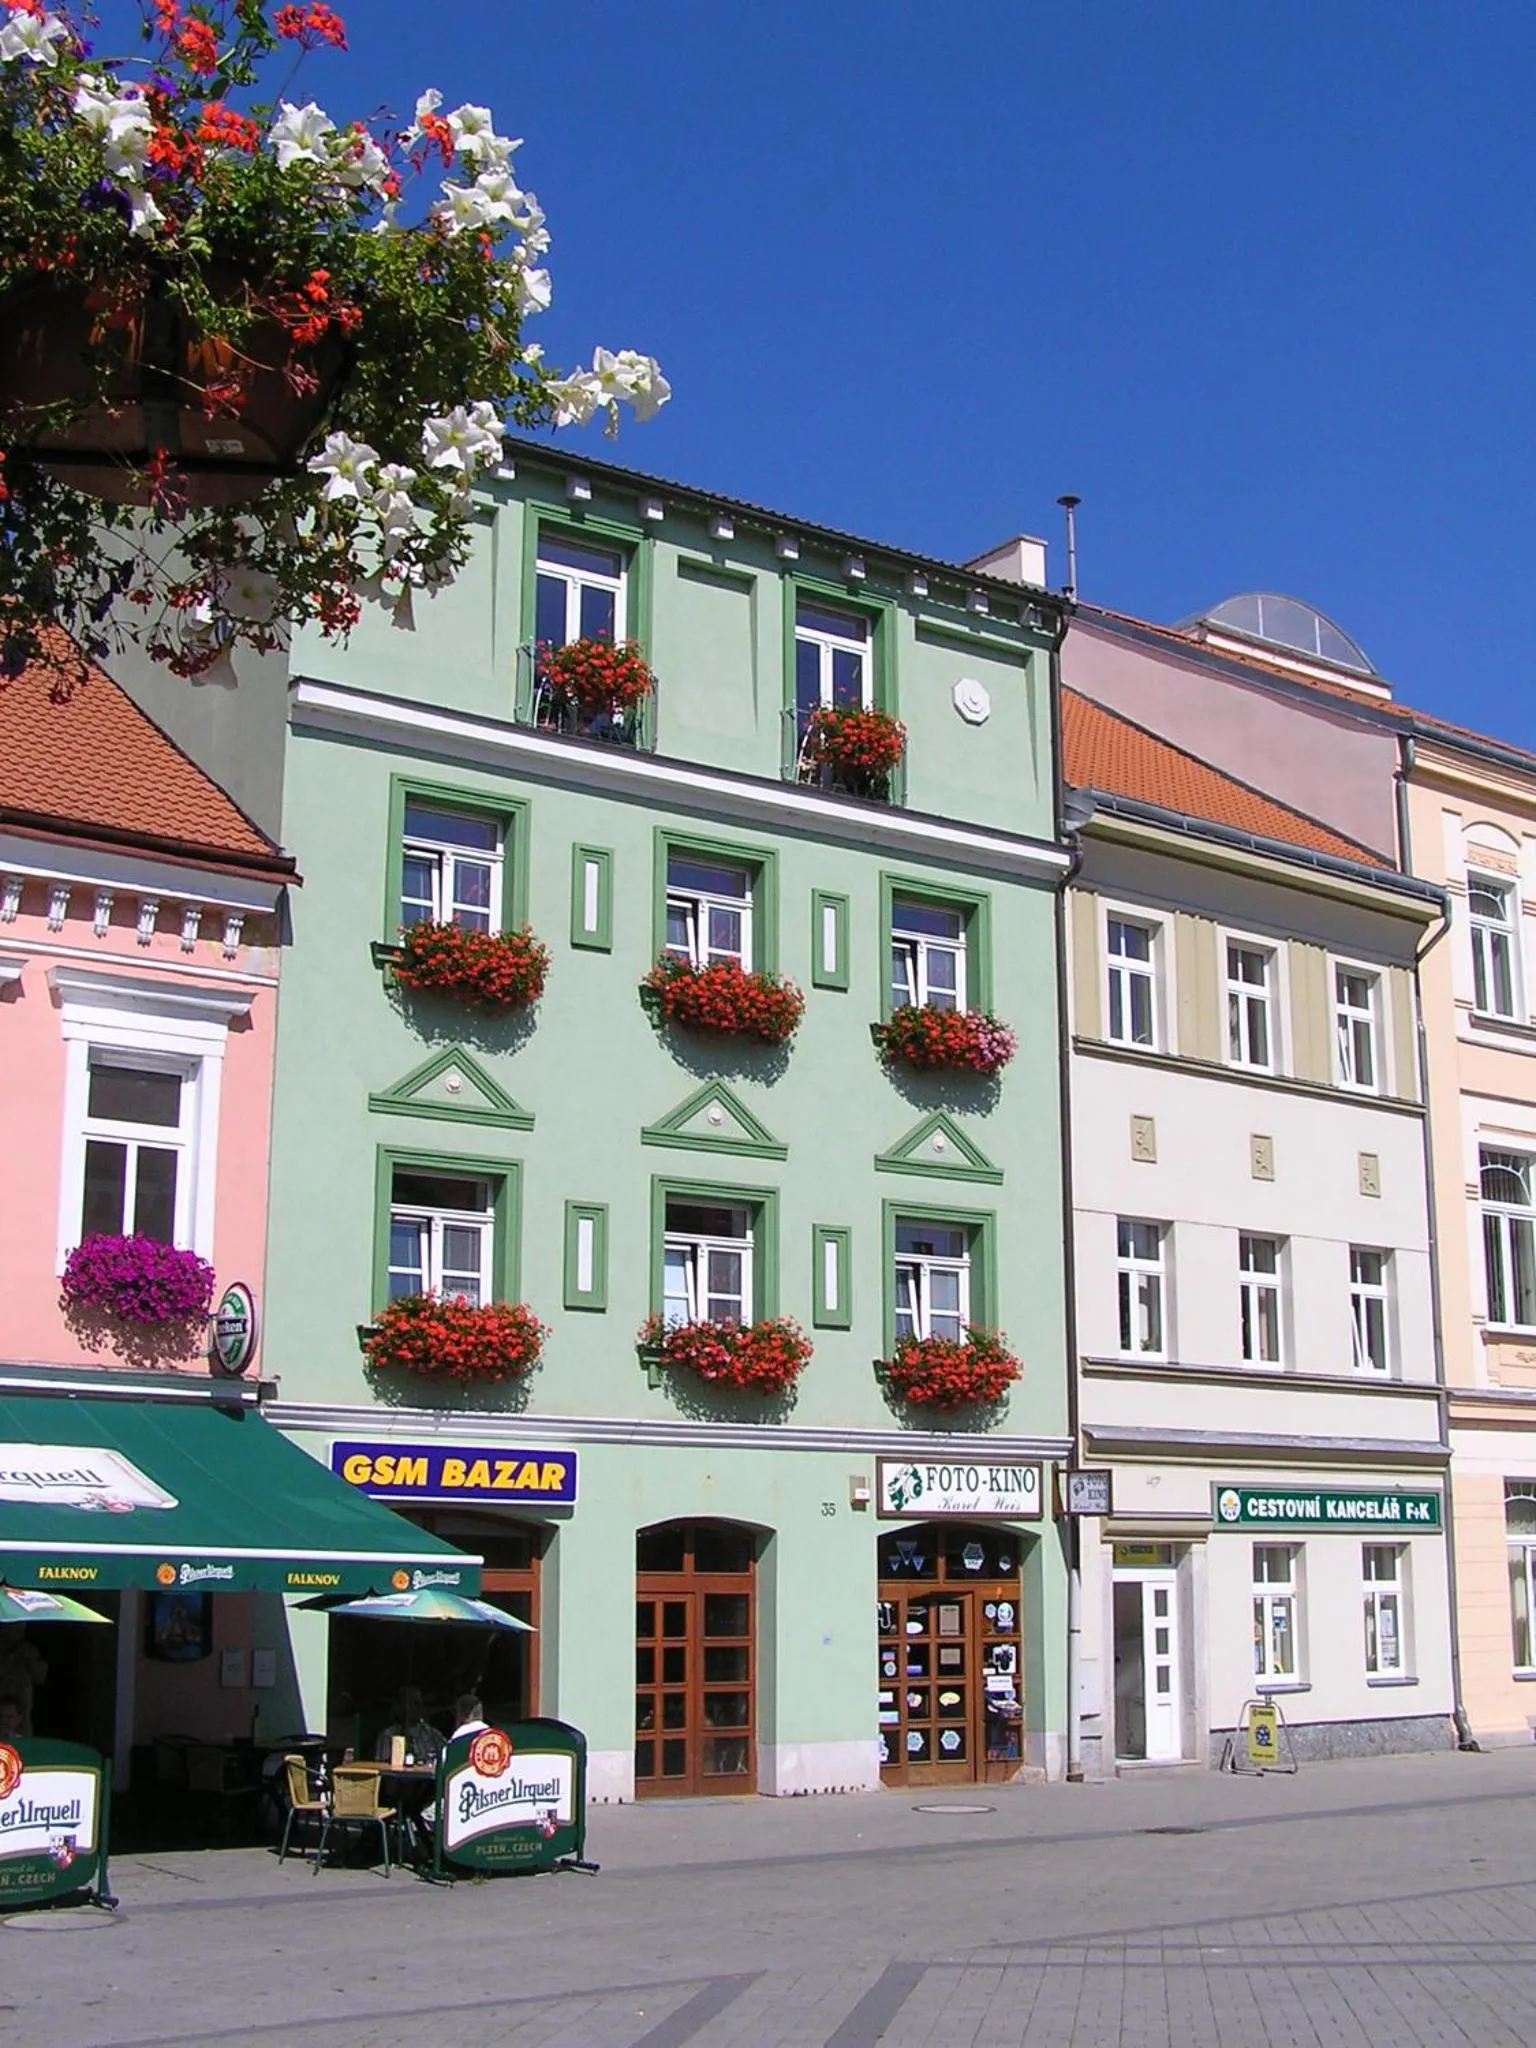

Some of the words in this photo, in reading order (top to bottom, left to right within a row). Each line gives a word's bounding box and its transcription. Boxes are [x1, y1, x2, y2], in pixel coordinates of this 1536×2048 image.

[343, 1454, 428, 1486] GSM
[441, 1458, 566, 1491] BAZAR
[926, 1466, 1036, 1493] FOTO-KINO
[821, 1502, 836, 1517] 35
[1247, 1496, 1320, 1518] CESTOVNÍ
[1326, 1497, 1400, 1519] KANCELÁŘ
[1406, 1502, 1430, 1520] F+K
[39, 1566, 98, 1580] FALKNOV
[287, 1572, 340, 1585] FALKNOV
[459, 1780, 512, 1823] Pilsner
[511, 1777, 560, 1806] Urquell
[18, 1797, 81, 1832] Urquell
[18, 1872, 57, 1886] CZECH
